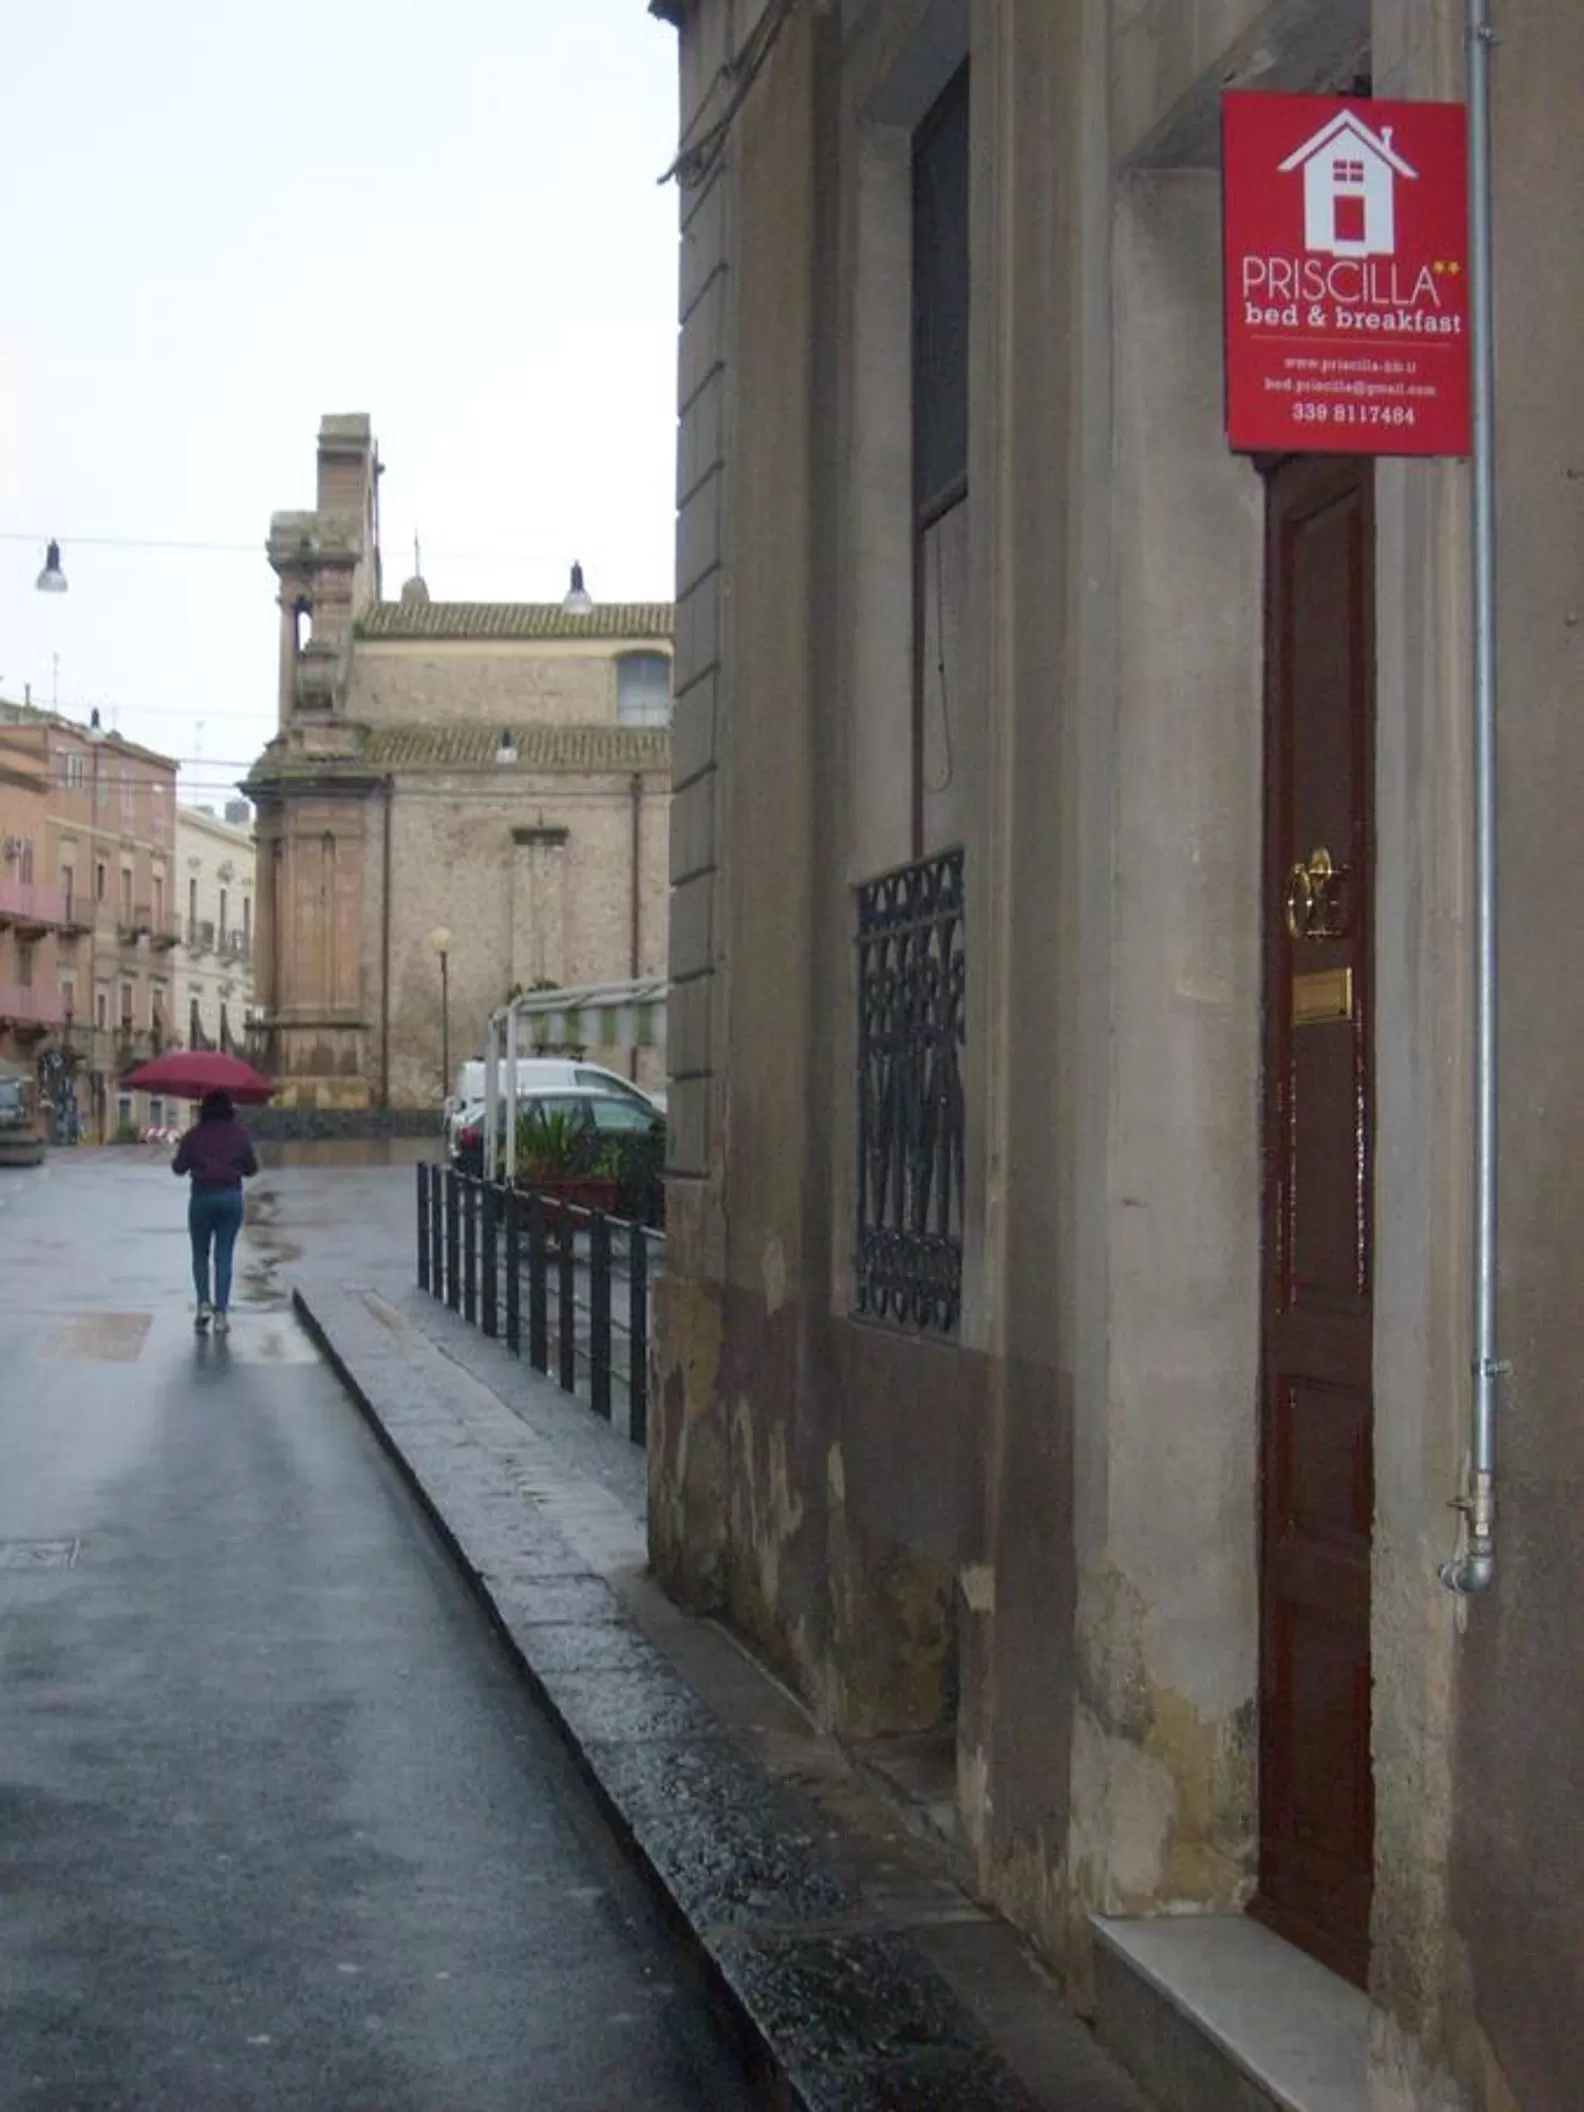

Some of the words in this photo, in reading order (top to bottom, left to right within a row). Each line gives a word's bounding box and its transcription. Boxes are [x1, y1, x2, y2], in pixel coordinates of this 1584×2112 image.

[1243, 256, 1441, 308] PRISCILLA
[1245, 303, 1298, 326] bed
[1307, 305, 1327, 327] &
[1335, 306, 1461, 333] breakfast
[1292, 401, 1328, 422] 339
